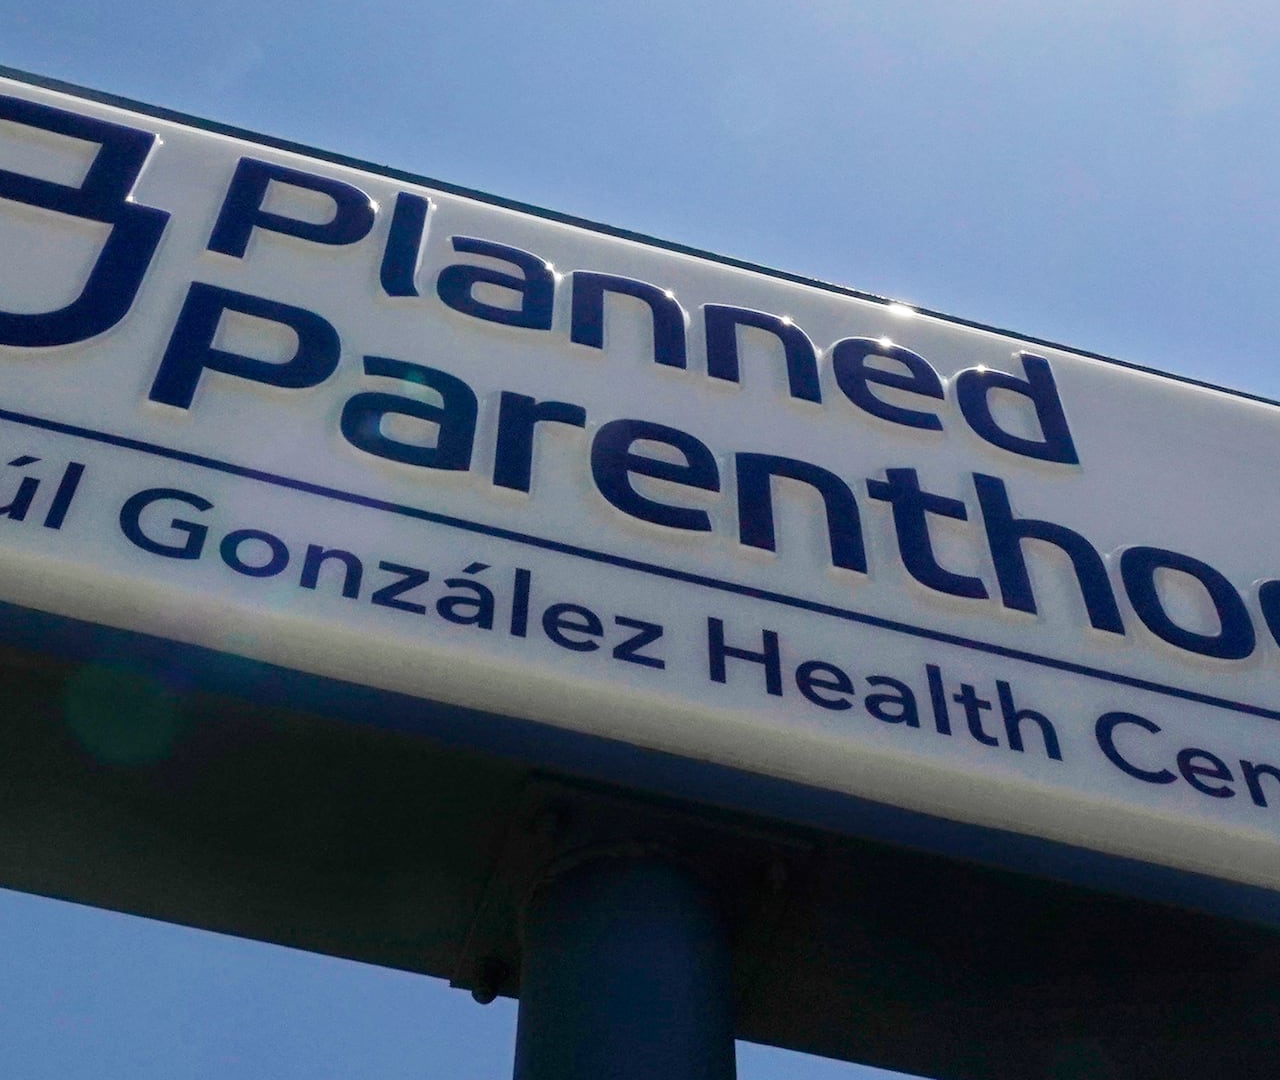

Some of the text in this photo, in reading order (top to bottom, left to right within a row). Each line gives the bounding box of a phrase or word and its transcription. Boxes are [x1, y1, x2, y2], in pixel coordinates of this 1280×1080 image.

[204, 156, 1082, 467] Planned
[116, 487, 667, 671] González
[704, 616, 1065, 762] Health
